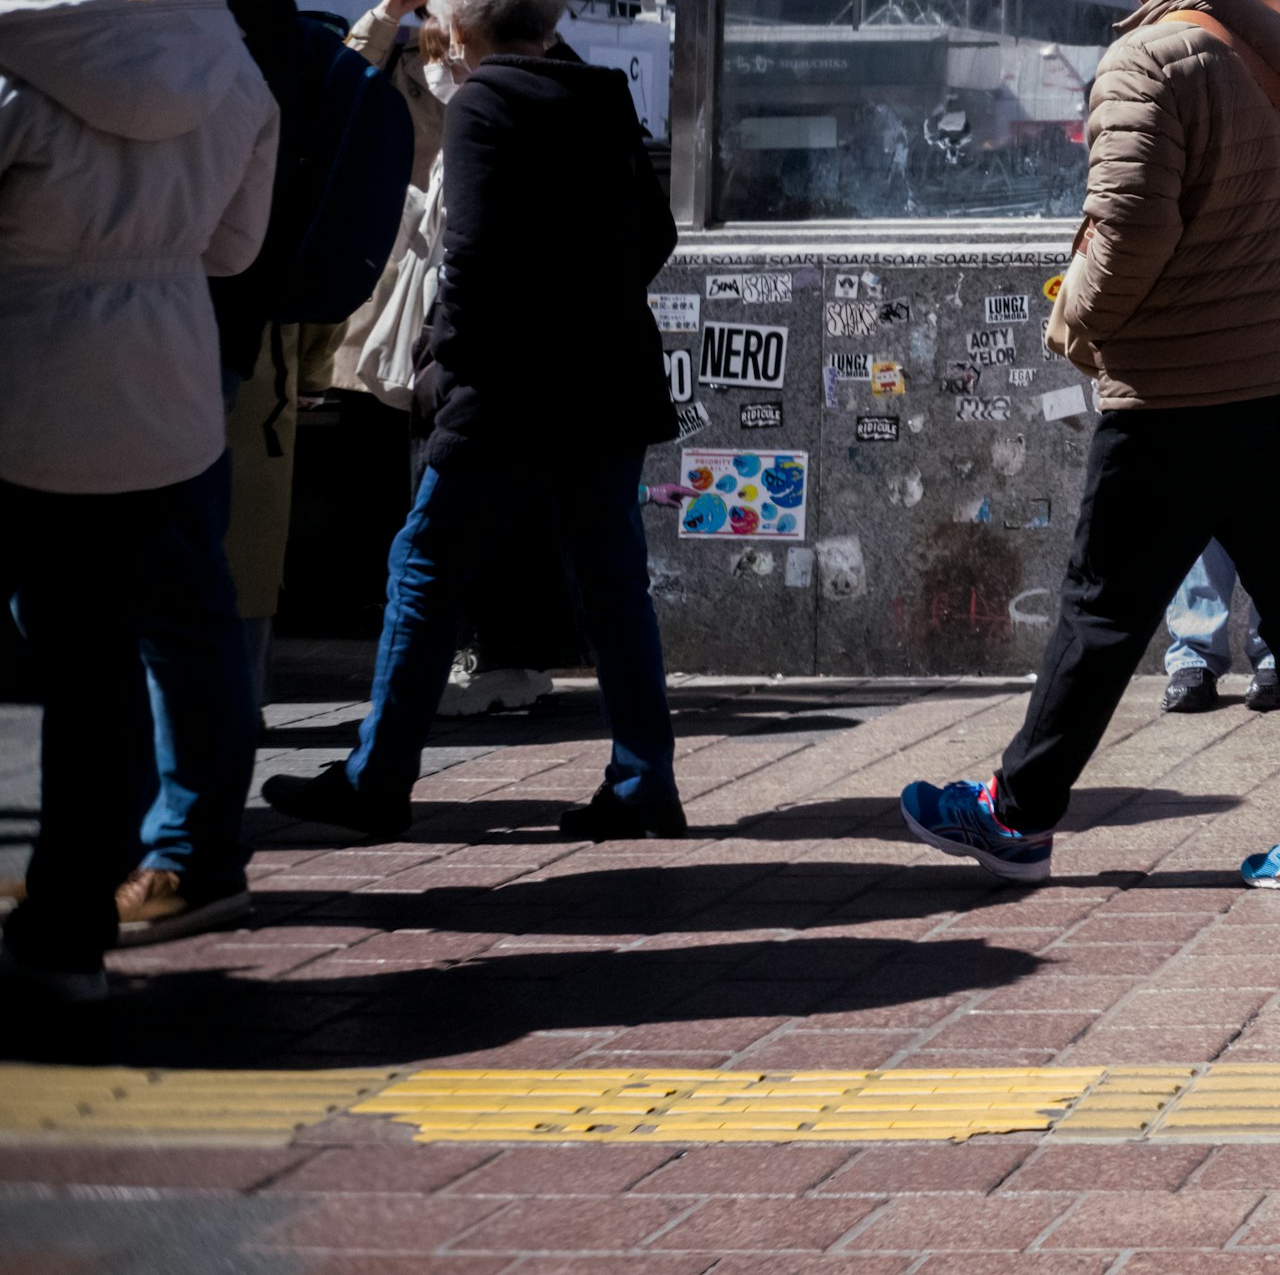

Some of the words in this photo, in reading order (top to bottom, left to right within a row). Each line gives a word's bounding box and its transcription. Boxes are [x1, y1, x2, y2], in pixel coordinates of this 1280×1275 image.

[768, 253, 815, 265] SOAR
[825, 253, 873, 265] SOAR
[882, 254, 928, 265] SOAR
[933, 253, 980, 265] SOAR
[990, 253, 1036, 265] SOAR
[988, 296, 1026, 314] LUNGZ
[700, 327, 784, 382] NERO
[741, 408, 782, 421] RIDICULE
[857, 421, 898, 436] RIDICULE
